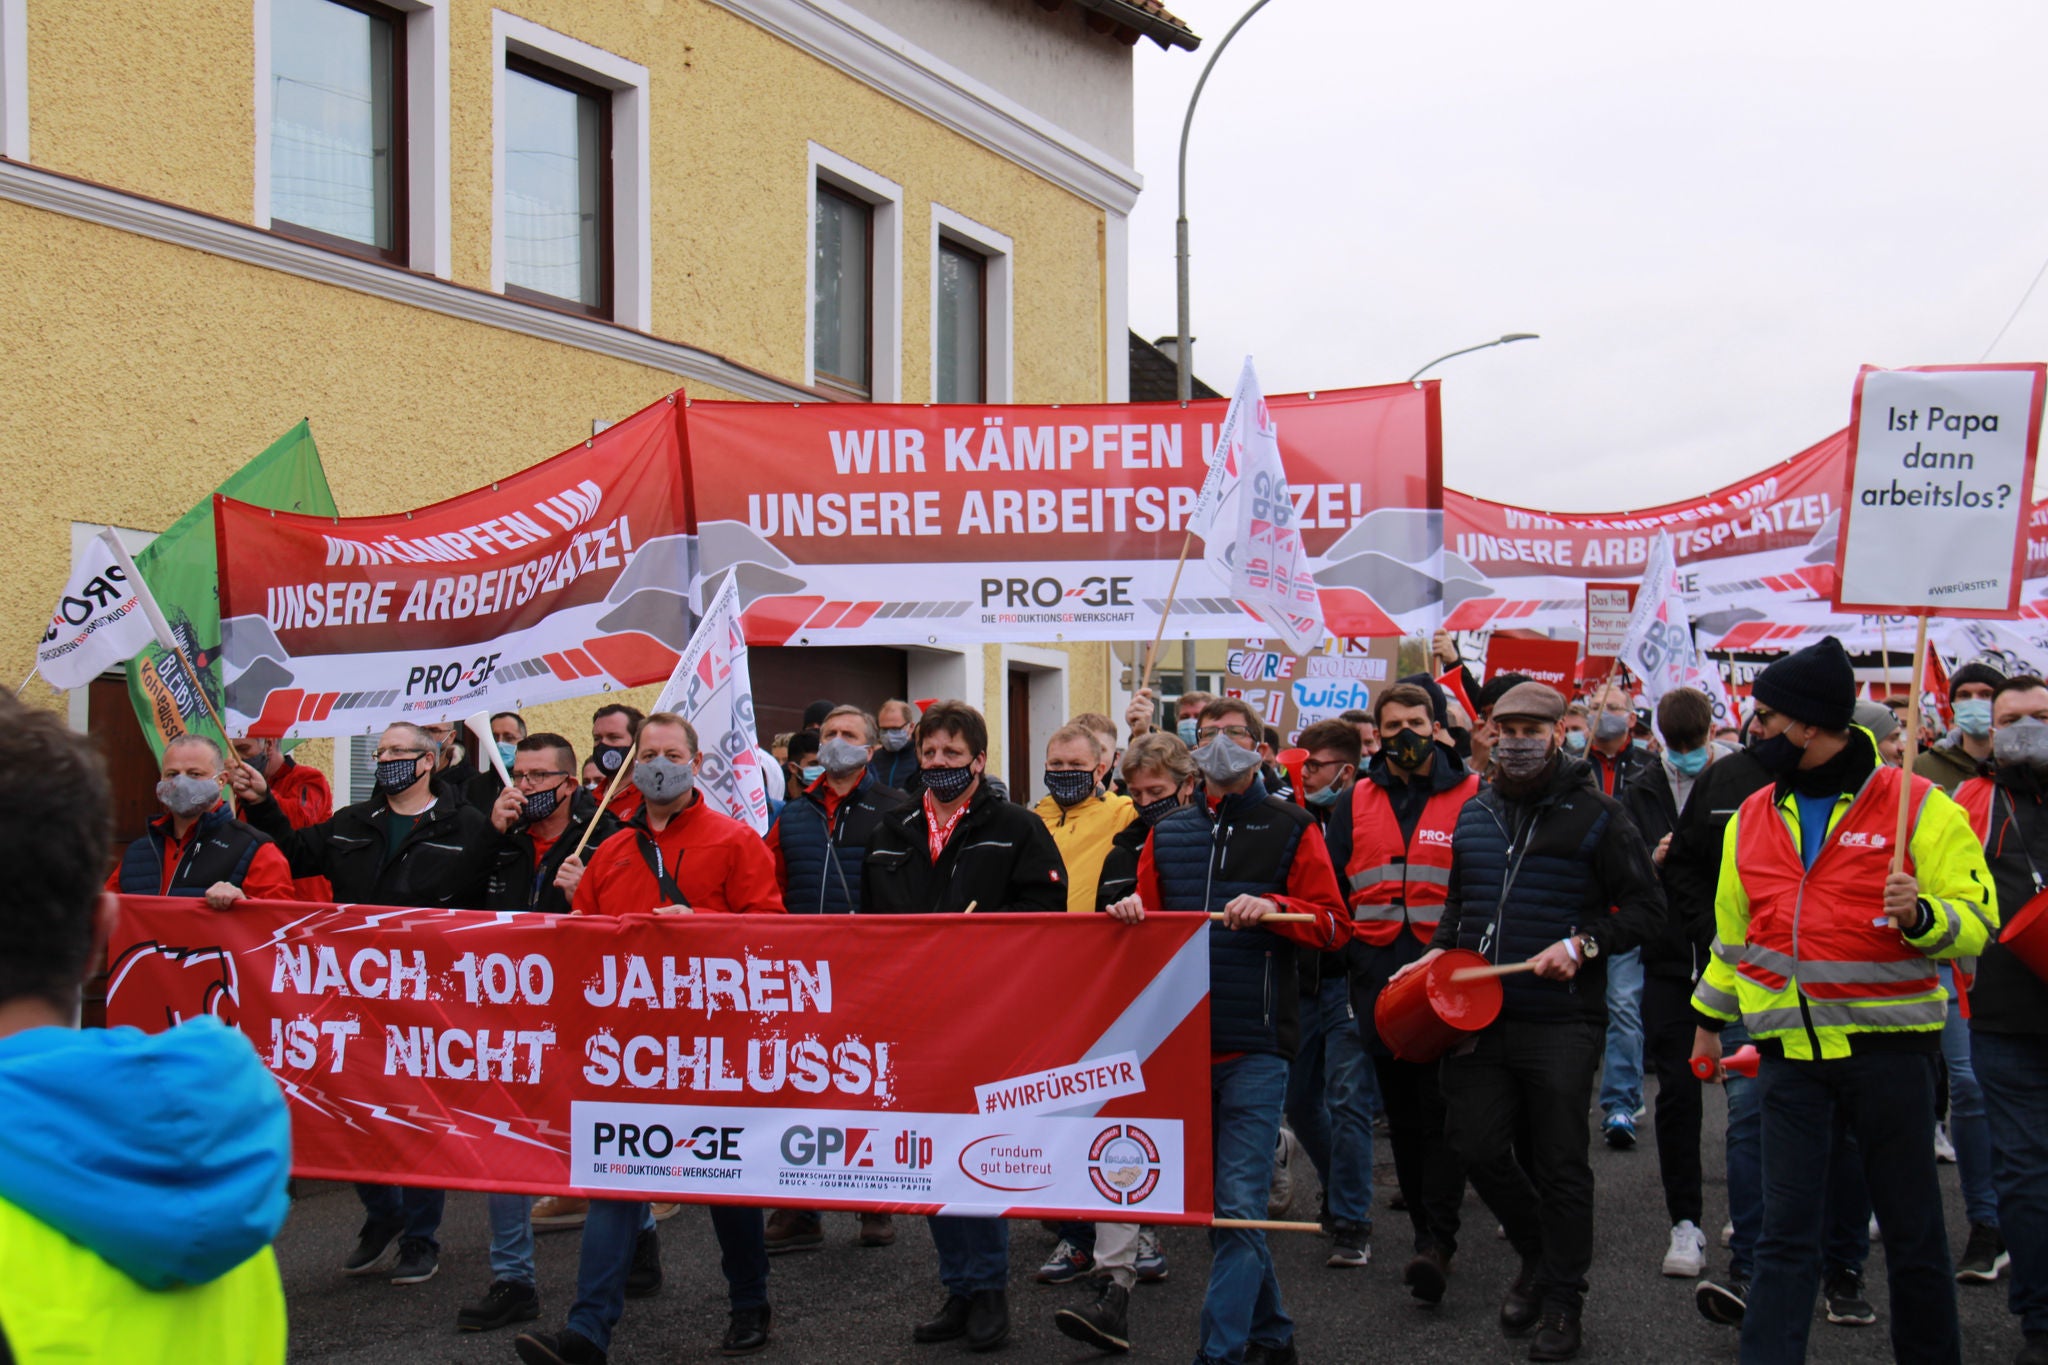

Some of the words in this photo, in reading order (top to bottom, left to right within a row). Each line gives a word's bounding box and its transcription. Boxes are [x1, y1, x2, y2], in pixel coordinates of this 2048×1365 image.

[1888, 407, 1918, 431] Ist
[1927, 407, 1998, 439] Papa
[828, 429, 926, 474] WIR
[944, 417, 1184, 472] KÄMPFEN
[1903, 442, 1973, 469] dann
[1728, 477, 1778, 510] UM
[1861, 479, 2011, 509] arbeitslos?
[372, 511, 551, 565] KÄMPFEN
[534, 480, 602, 531] UM
[749, 491, 942, 537] UNSERE
[957, 483, 1362, 534] ARBEITSPZE!
[1456, 532, 1573, 567] UNSERE
[267, 581, 396, 631] UNSERE
[399, 515, 635, 622] ARBEITSPLÄTZE!
[1928, 579, 1998, 596] #WIRFÜRSTEYR
[1592, 594, 1608, 606] Das
[1611, 593, 1626, 605] hat
[981, 614, 997, 624] DIE
[999, 612, 1135, 624] PRODUKTIONSGEWERKSCHAFT
[1592, 616, 1614, 630] Steyr
[1309, 657, 1385, 680] MORAL
[141, 661, 184, 742] Kohleausst
[271, 943, 428, 1001] NACH
[453, 951, 555, 1007] 100
[583, 951, 833, 1018] JAHREN
[270, 1014, 361, 1074] IST
[384, 1022, 558, 1085] NICHT
[582, 1029, 893, 1103] SCHLUSS!
[986, 1061, 1135, 1114] #WIRFÜRSTEYR
[594, 1122, 745, 1161] PRO-GE
[894, 1129, 933, 1170] djp
[990, 1145, 1043, 1159] rundum
[593, 1163, 608, 1174] DIE
[610, 1164, 743, 1180] PRODUKTIONSGEWERKSCHAFT
[779, 1171, 836, 1181] GEWERKSCHAFT
[838, 1174, 852, 1182] DER
[854, 1174, 932, 1184] PRIVATANGESTELLTEN
[980, 1160, 1001, 1177] gut
[1004, 1160, 1052, 1175] betreut
[778, 1179, 807, 1187] DRUCK
[820, 1181, 889, 1190] JOURNALISMUS
[901, 1184, 932, 1192] PAPIER
